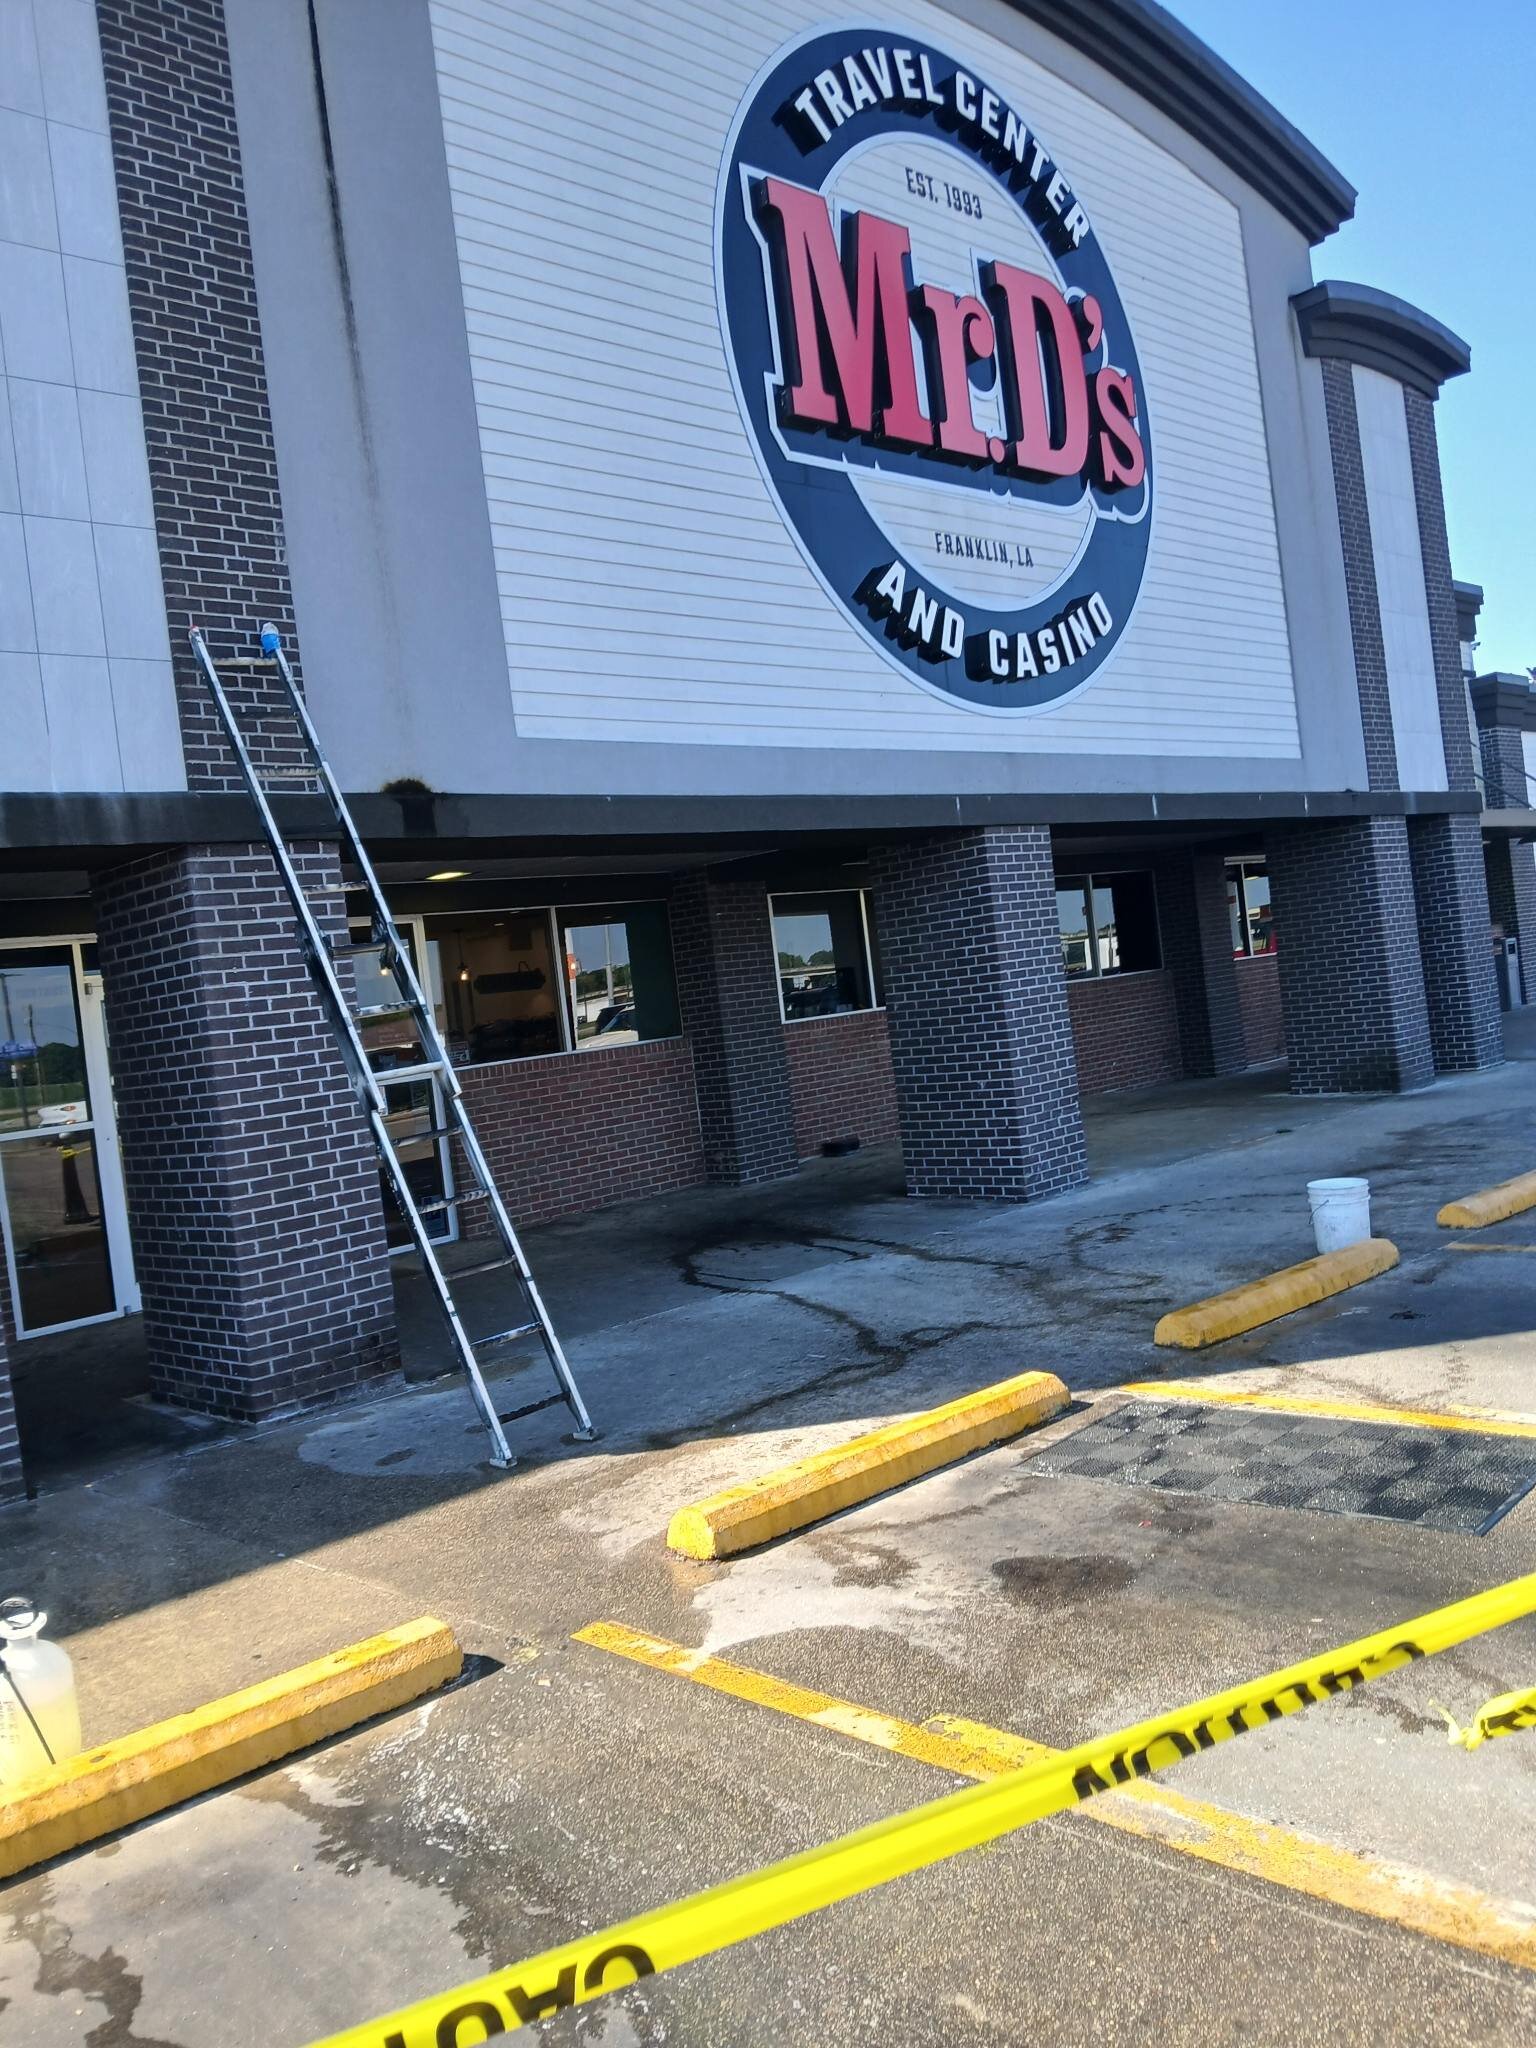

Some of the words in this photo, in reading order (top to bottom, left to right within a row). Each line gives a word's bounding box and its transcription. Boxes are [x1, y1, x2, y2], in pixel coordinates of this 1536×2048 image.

[795, 47, 944, 142] TRAVEL
[955, 70, 1091, 248] CENTER
[905, 166, 938, 204] EST.
[943, 182, 983, 220] 1993
[935, 532, 1013, 569] FRANKLIN,
[1016, 545, 1034, 568] LA
[876, 560, 965, 659] AND
[988, 591, 1113, 679] CASINO
